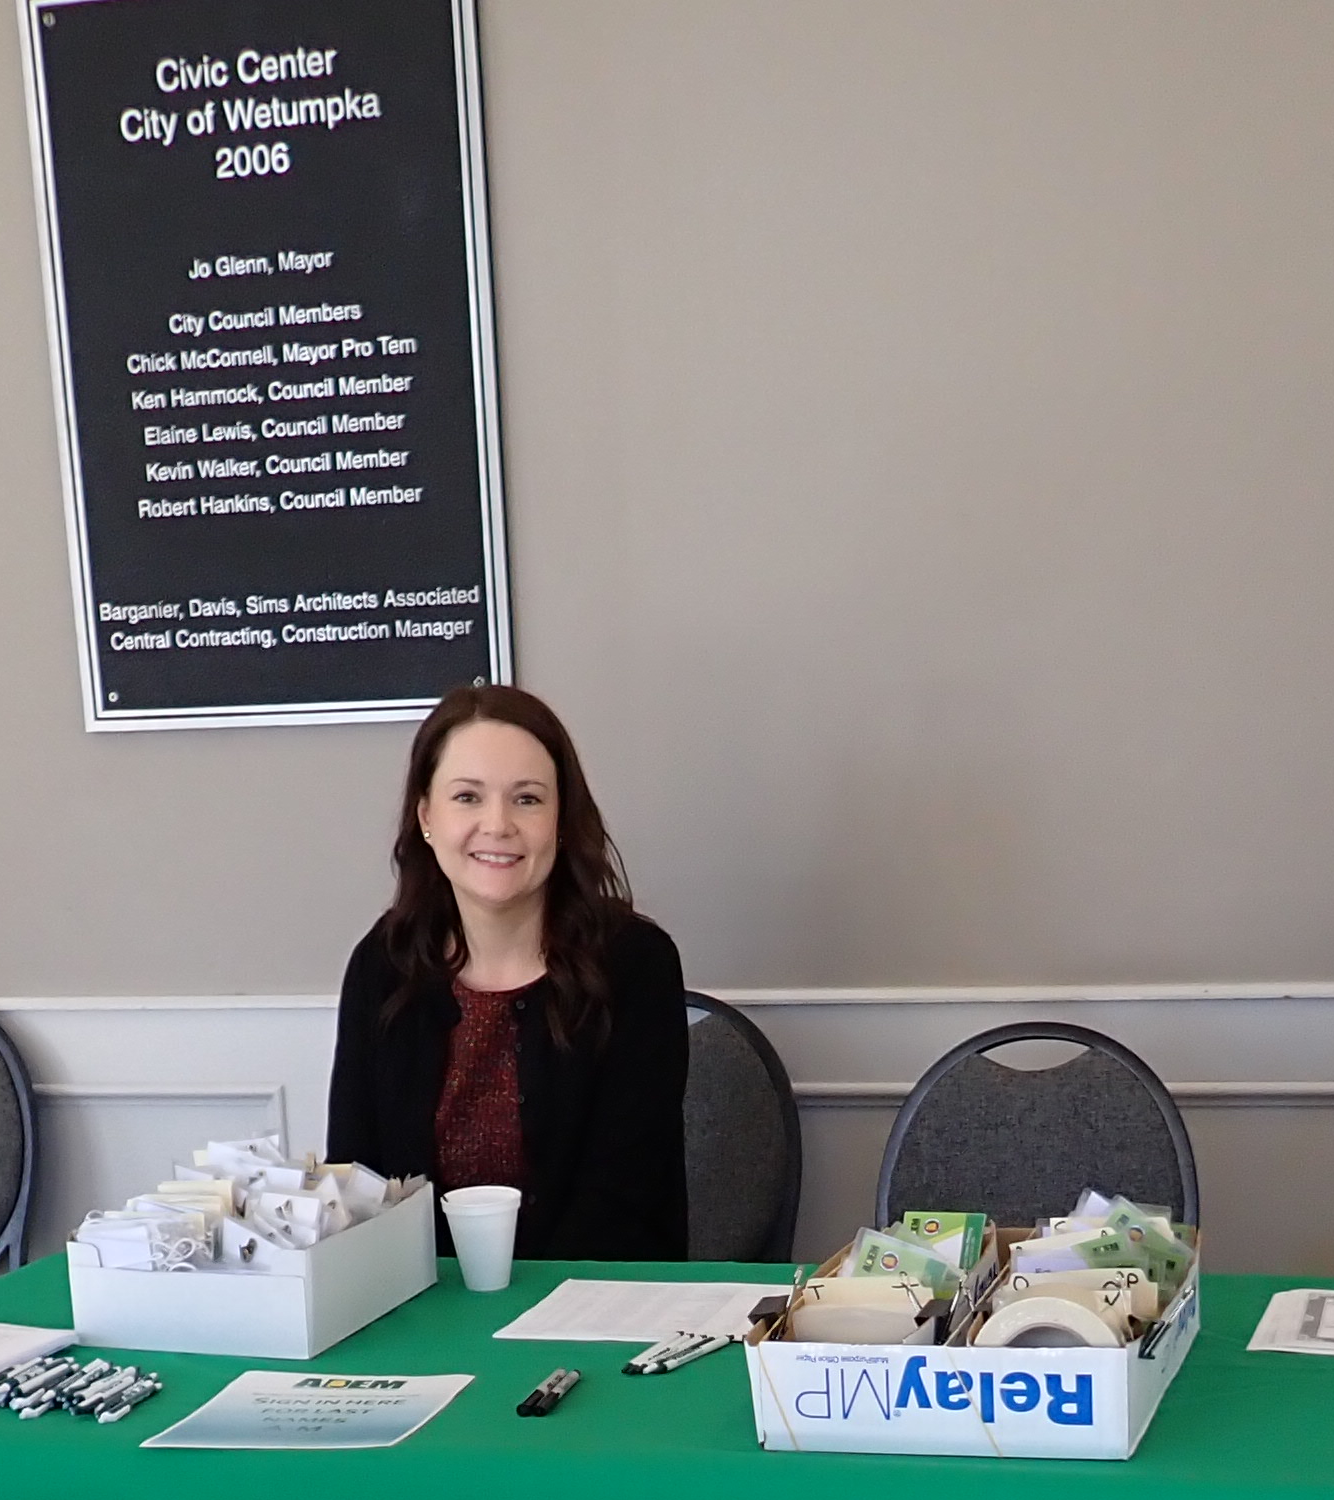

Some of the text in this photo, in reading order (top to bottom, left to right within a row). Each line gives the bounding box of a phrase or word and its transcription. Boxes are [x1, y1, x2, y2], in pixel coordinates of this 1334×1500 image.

[156, 47, 337, 92] Civic Center
[120, 88, 381, 146] City of Wetumpka
[216, 142, 290, 178] 2006
[189, 251, 334, 279] Jo Glenn, Mayor
[169, 303, 362, 336] City Council Members
[127, 336, 417, 374] Chick McConnell, Mayor Pro Tem
[132, 374, 413, 409] Ken Hammock, Council Member
[144, 412, 405, 445] Elaine Lewis, Council Member
[146, 449, 409, 481] Kevin Walker, Council Member
[138, 486, 423, 518] Robert Hankins, Council Member
[99, 585, 479, 624] Barganier, Davis, Sims Architects Associated
[111, 620, 473, 650] Central Contracting, Construction Manager
[293, 1378, 408, 1389] ADEM
